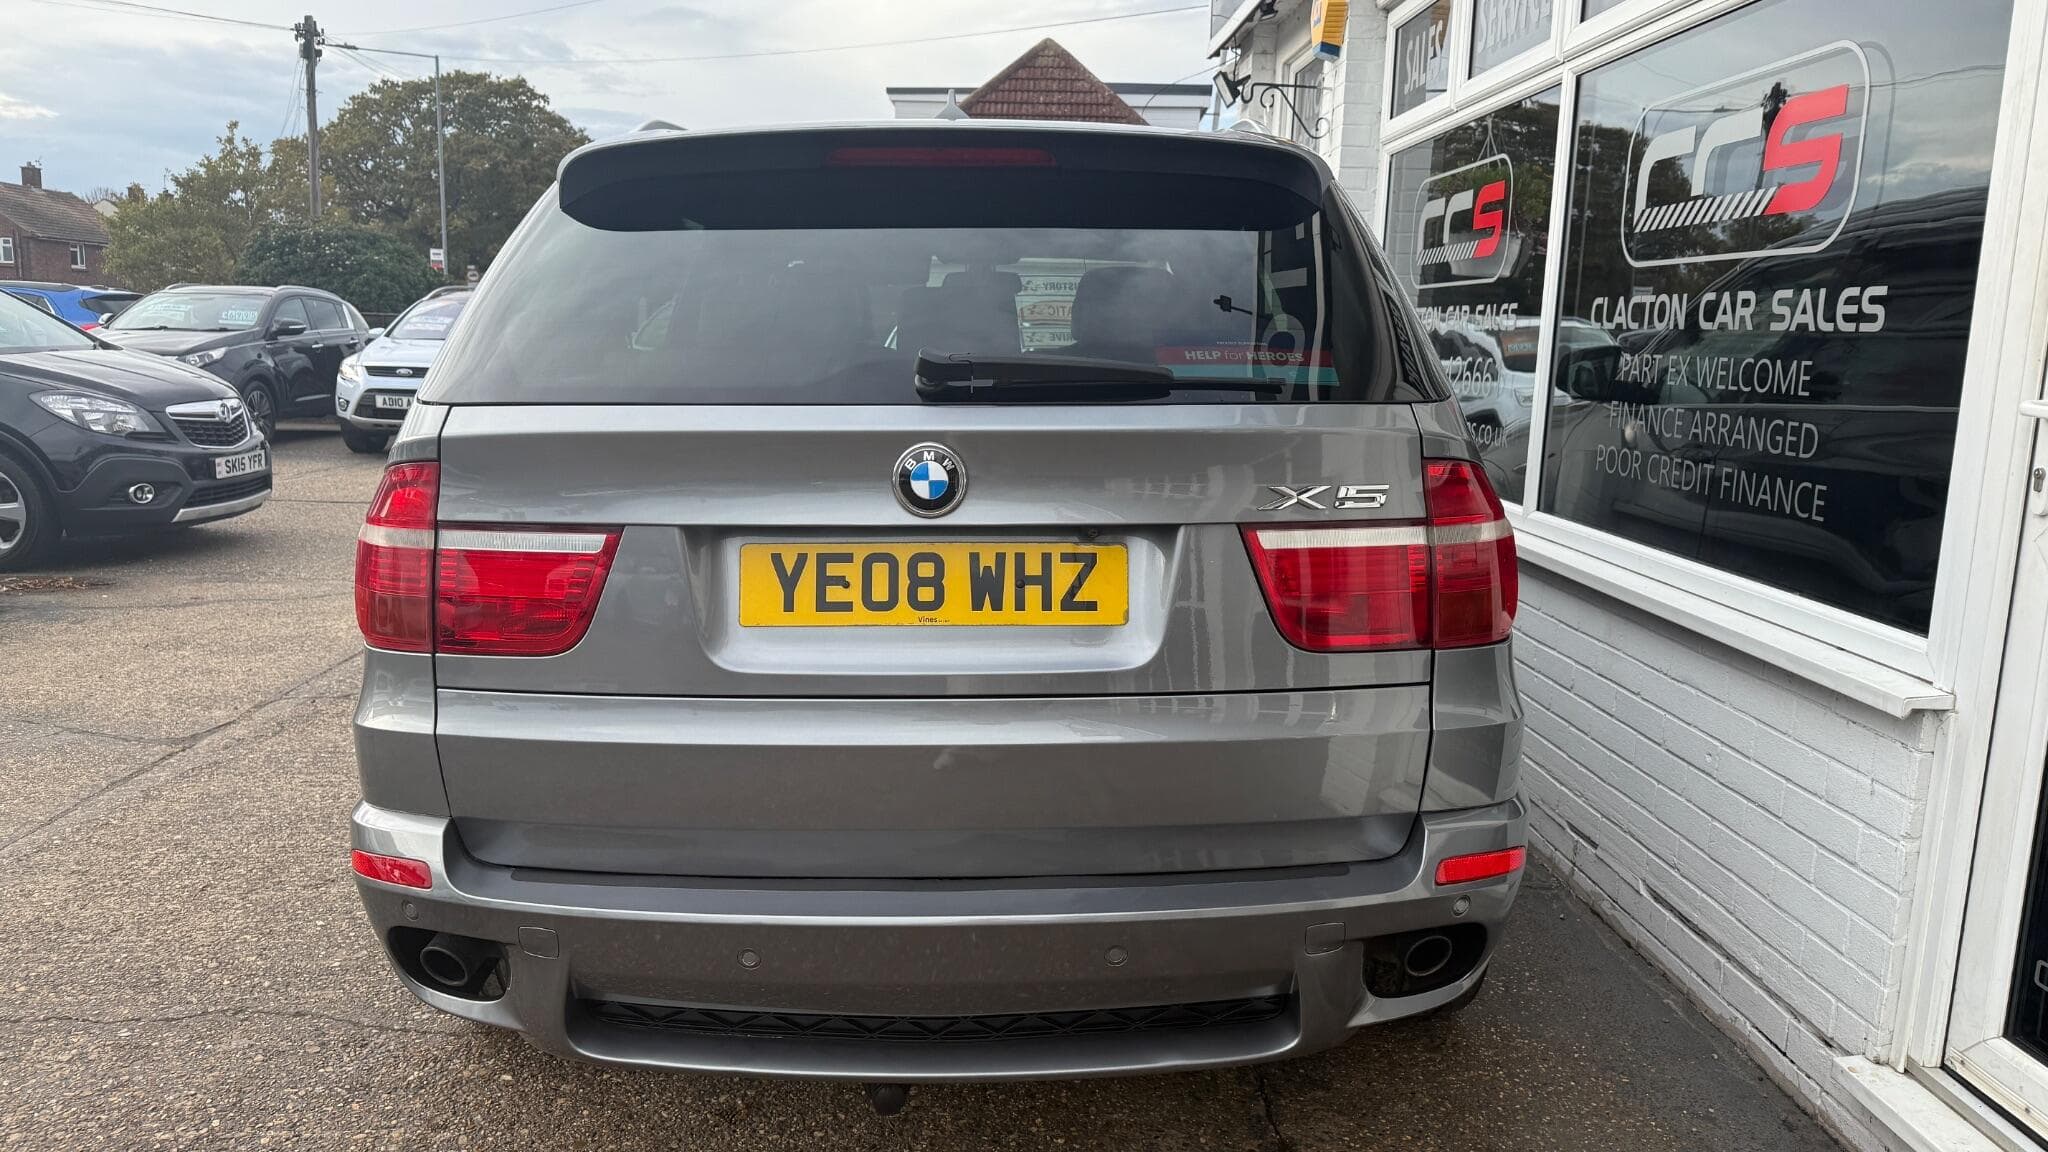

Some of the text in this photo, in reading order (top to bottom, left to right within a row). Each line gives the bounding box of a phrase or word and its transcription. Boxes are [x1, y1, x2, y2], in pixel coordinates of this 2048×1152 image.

[1404, 20, 1444, 95] SALES
[1634, 84, 1849, 232] CCS
[1416, 181, 1506, 265] CCS
[1445, 304, 1470, 331] CAR
[1475, 303, 1518, 331] SALES
[1590, 286, 1889, 333] CLACTON CAR SALES
[1184, 349, 1304, 362] HELP for HEROES
[1621, 353, 1814, 396] PART EX WELCOME
[1609, 400, 1819, 459] FINANCE ARRANGED
[225, 453, 263, 474] SK15 YFR
[904, 450, 955, 471] BMW
[1595, 444, 1828, 522] POOR CREDIT FINANCE
[1257, 484, 1390, 510] X5
[770, 551, 1099, 613] YE08 WHZ
[917, 615, 938, 623] Vines
